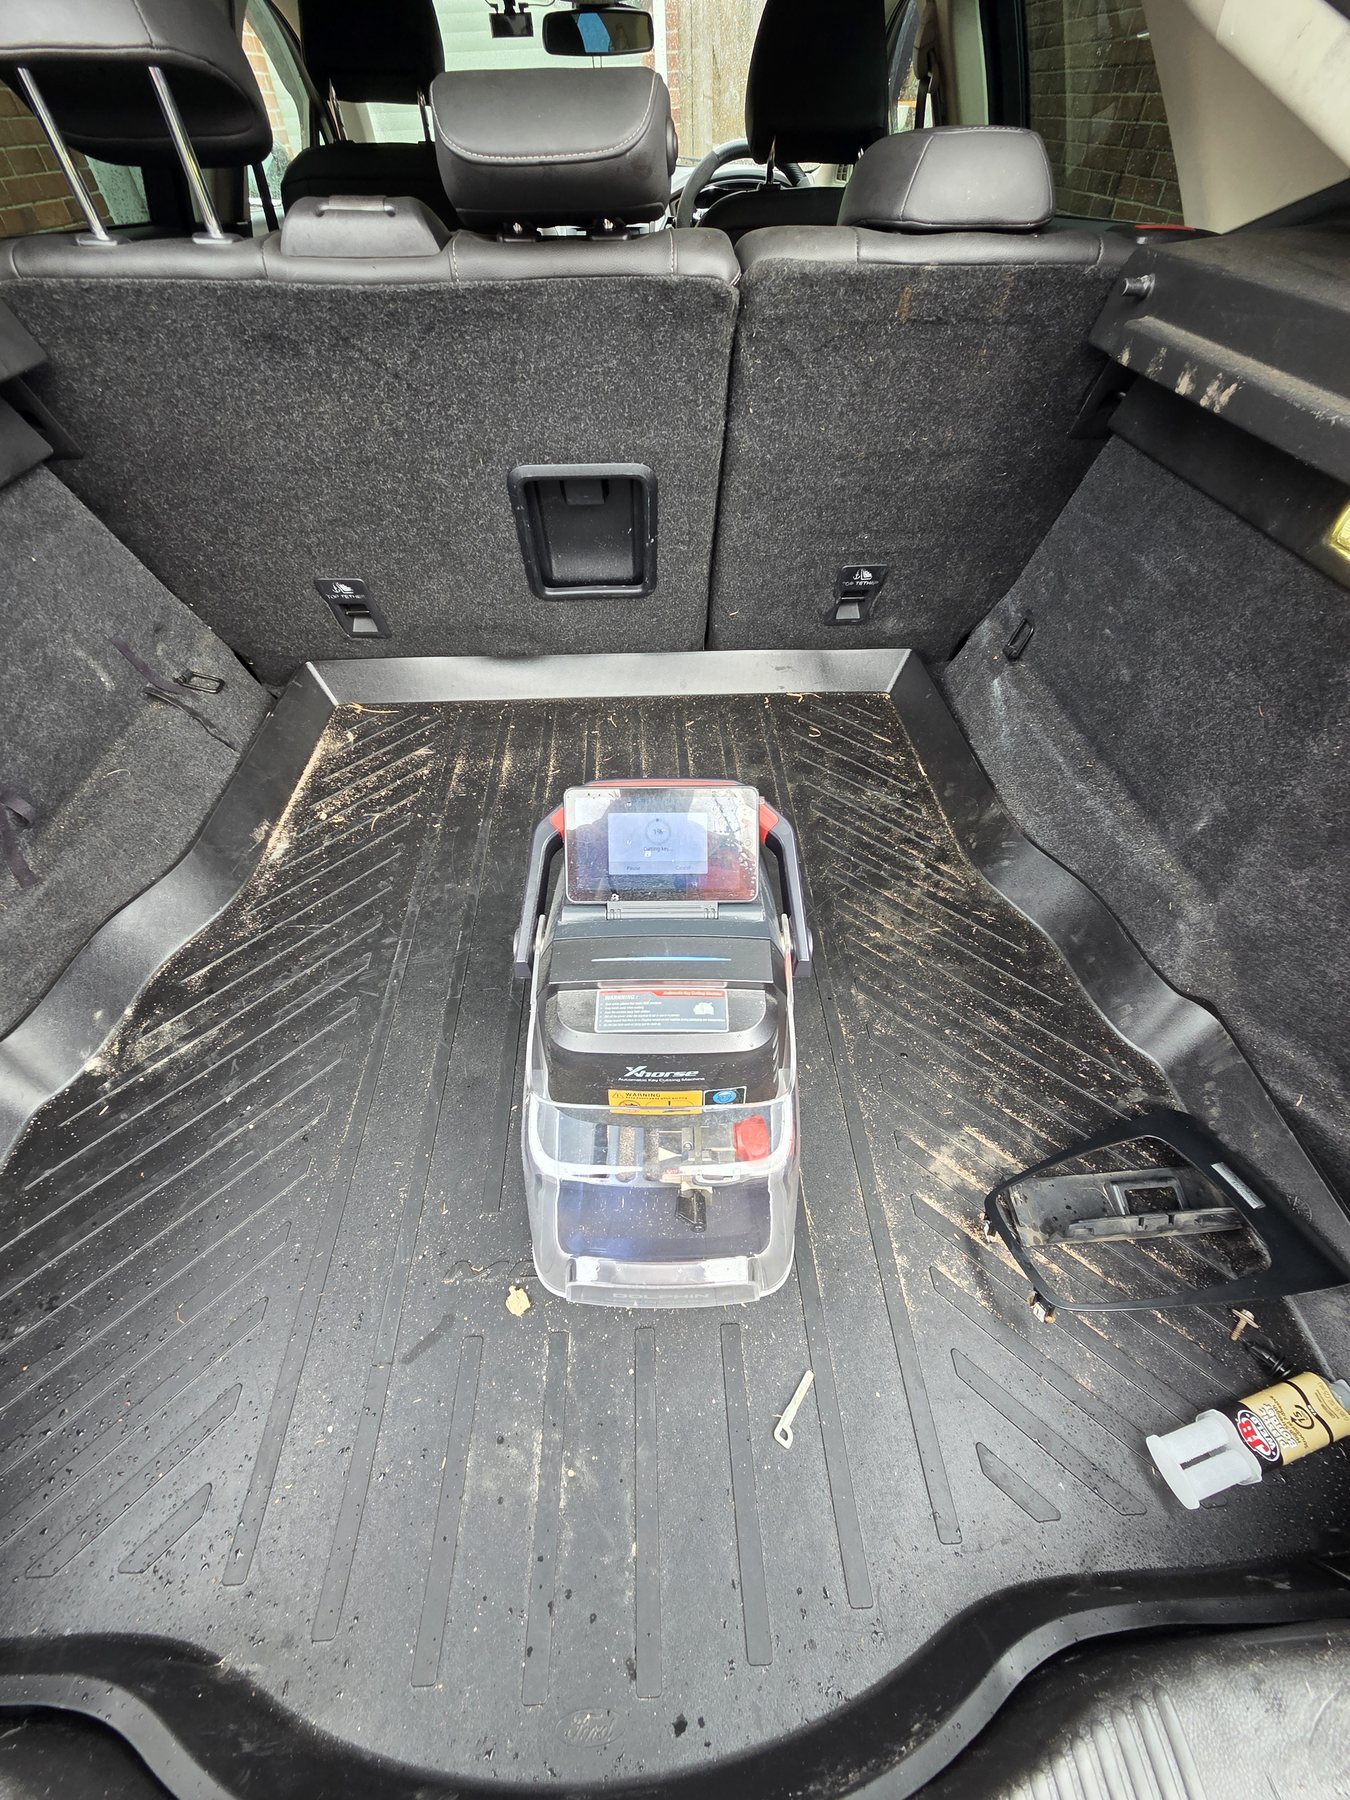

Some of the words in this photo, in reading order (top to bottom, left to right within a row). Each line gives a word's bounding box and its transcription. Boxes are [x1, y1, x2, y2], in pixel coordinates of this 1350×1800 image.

[624, 1065, 699, 1078] Xhorse
[1250, 1416, 1276, 1450] WELD
[1258, 1407, 1290, 1449] Plastic
[1263, 1403, 1298, 1448] Bonder
[565, 1713, 616, 1742] Ford
